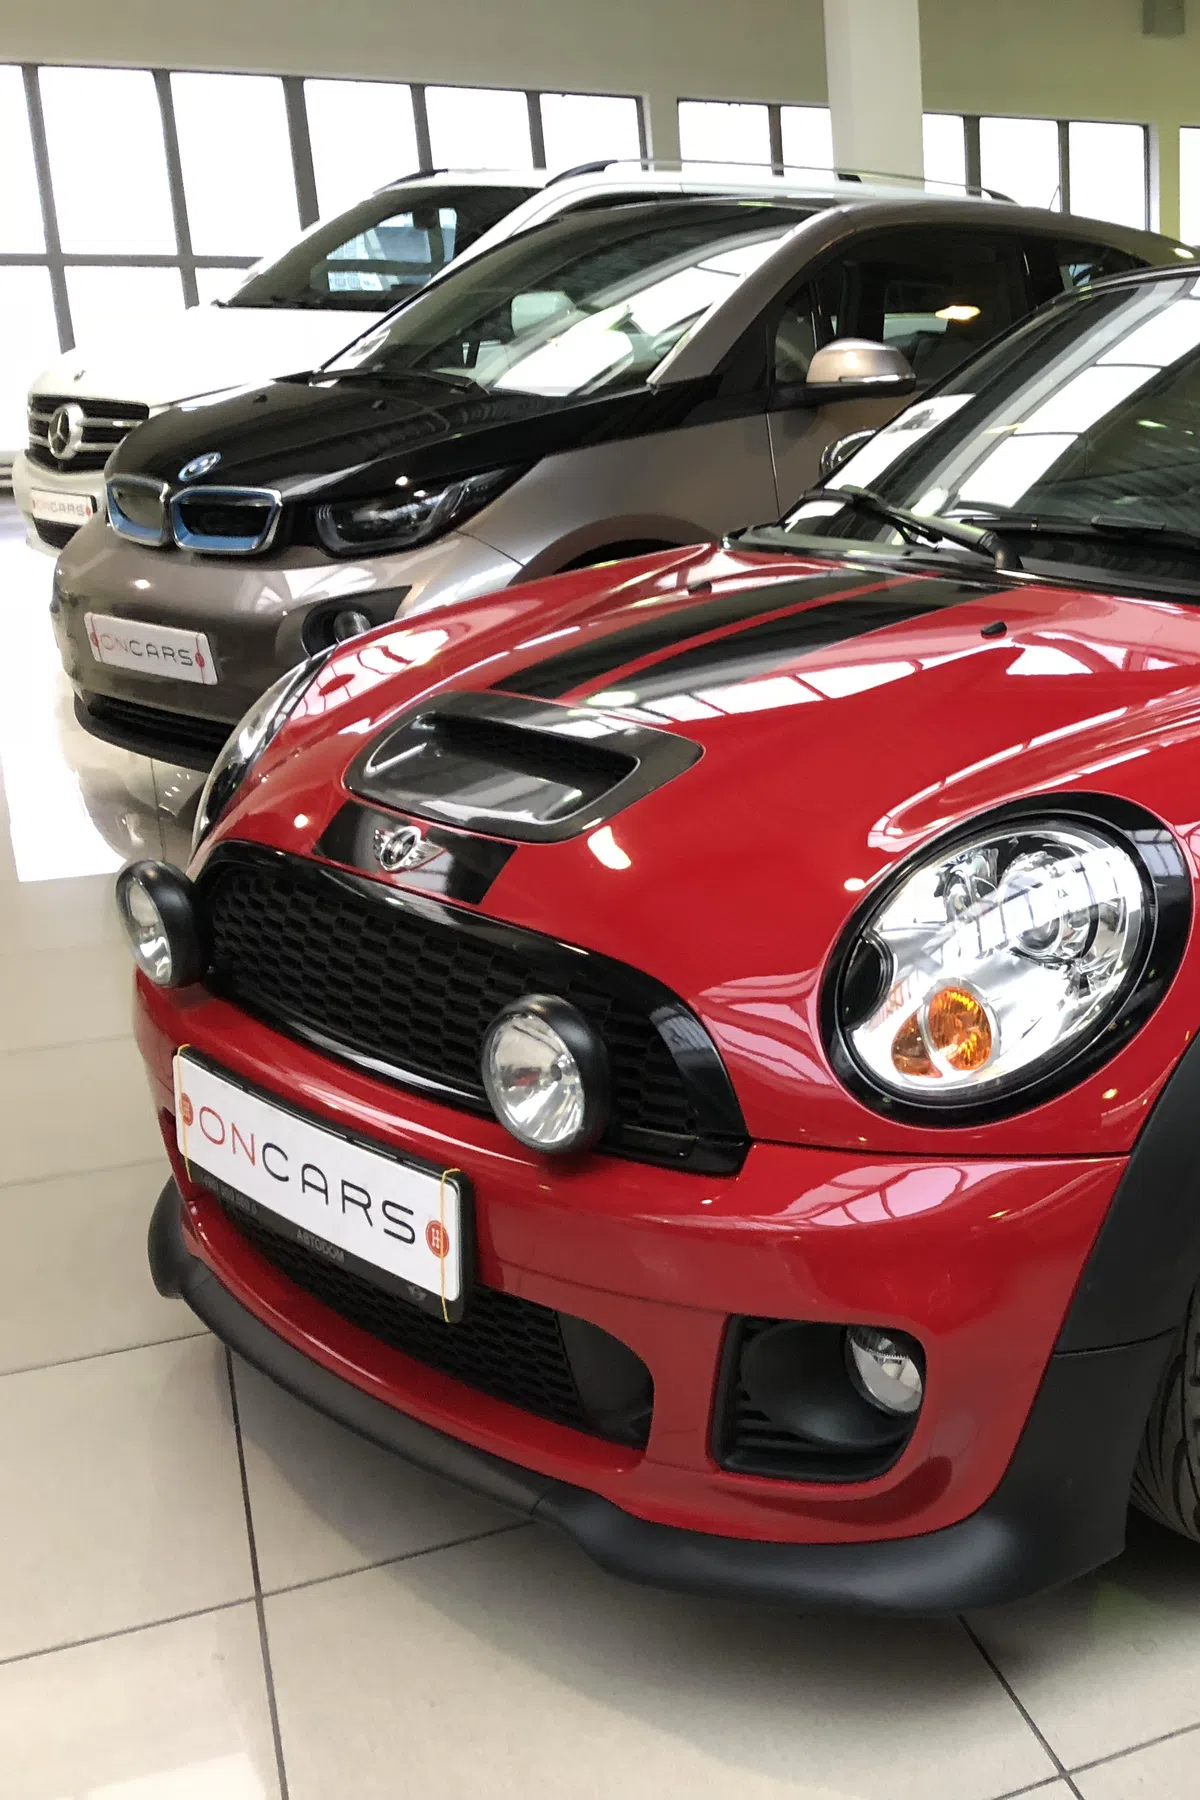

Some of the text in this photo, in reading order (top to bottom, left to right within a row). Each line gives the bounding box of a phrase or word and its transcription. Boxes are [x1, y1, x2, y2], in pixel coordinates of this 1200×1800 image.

[36, 499, 85, 517] CARS
[100, 632, 194, 667] ONCARS
[199, 1106, 416, 1245] ONCARS
